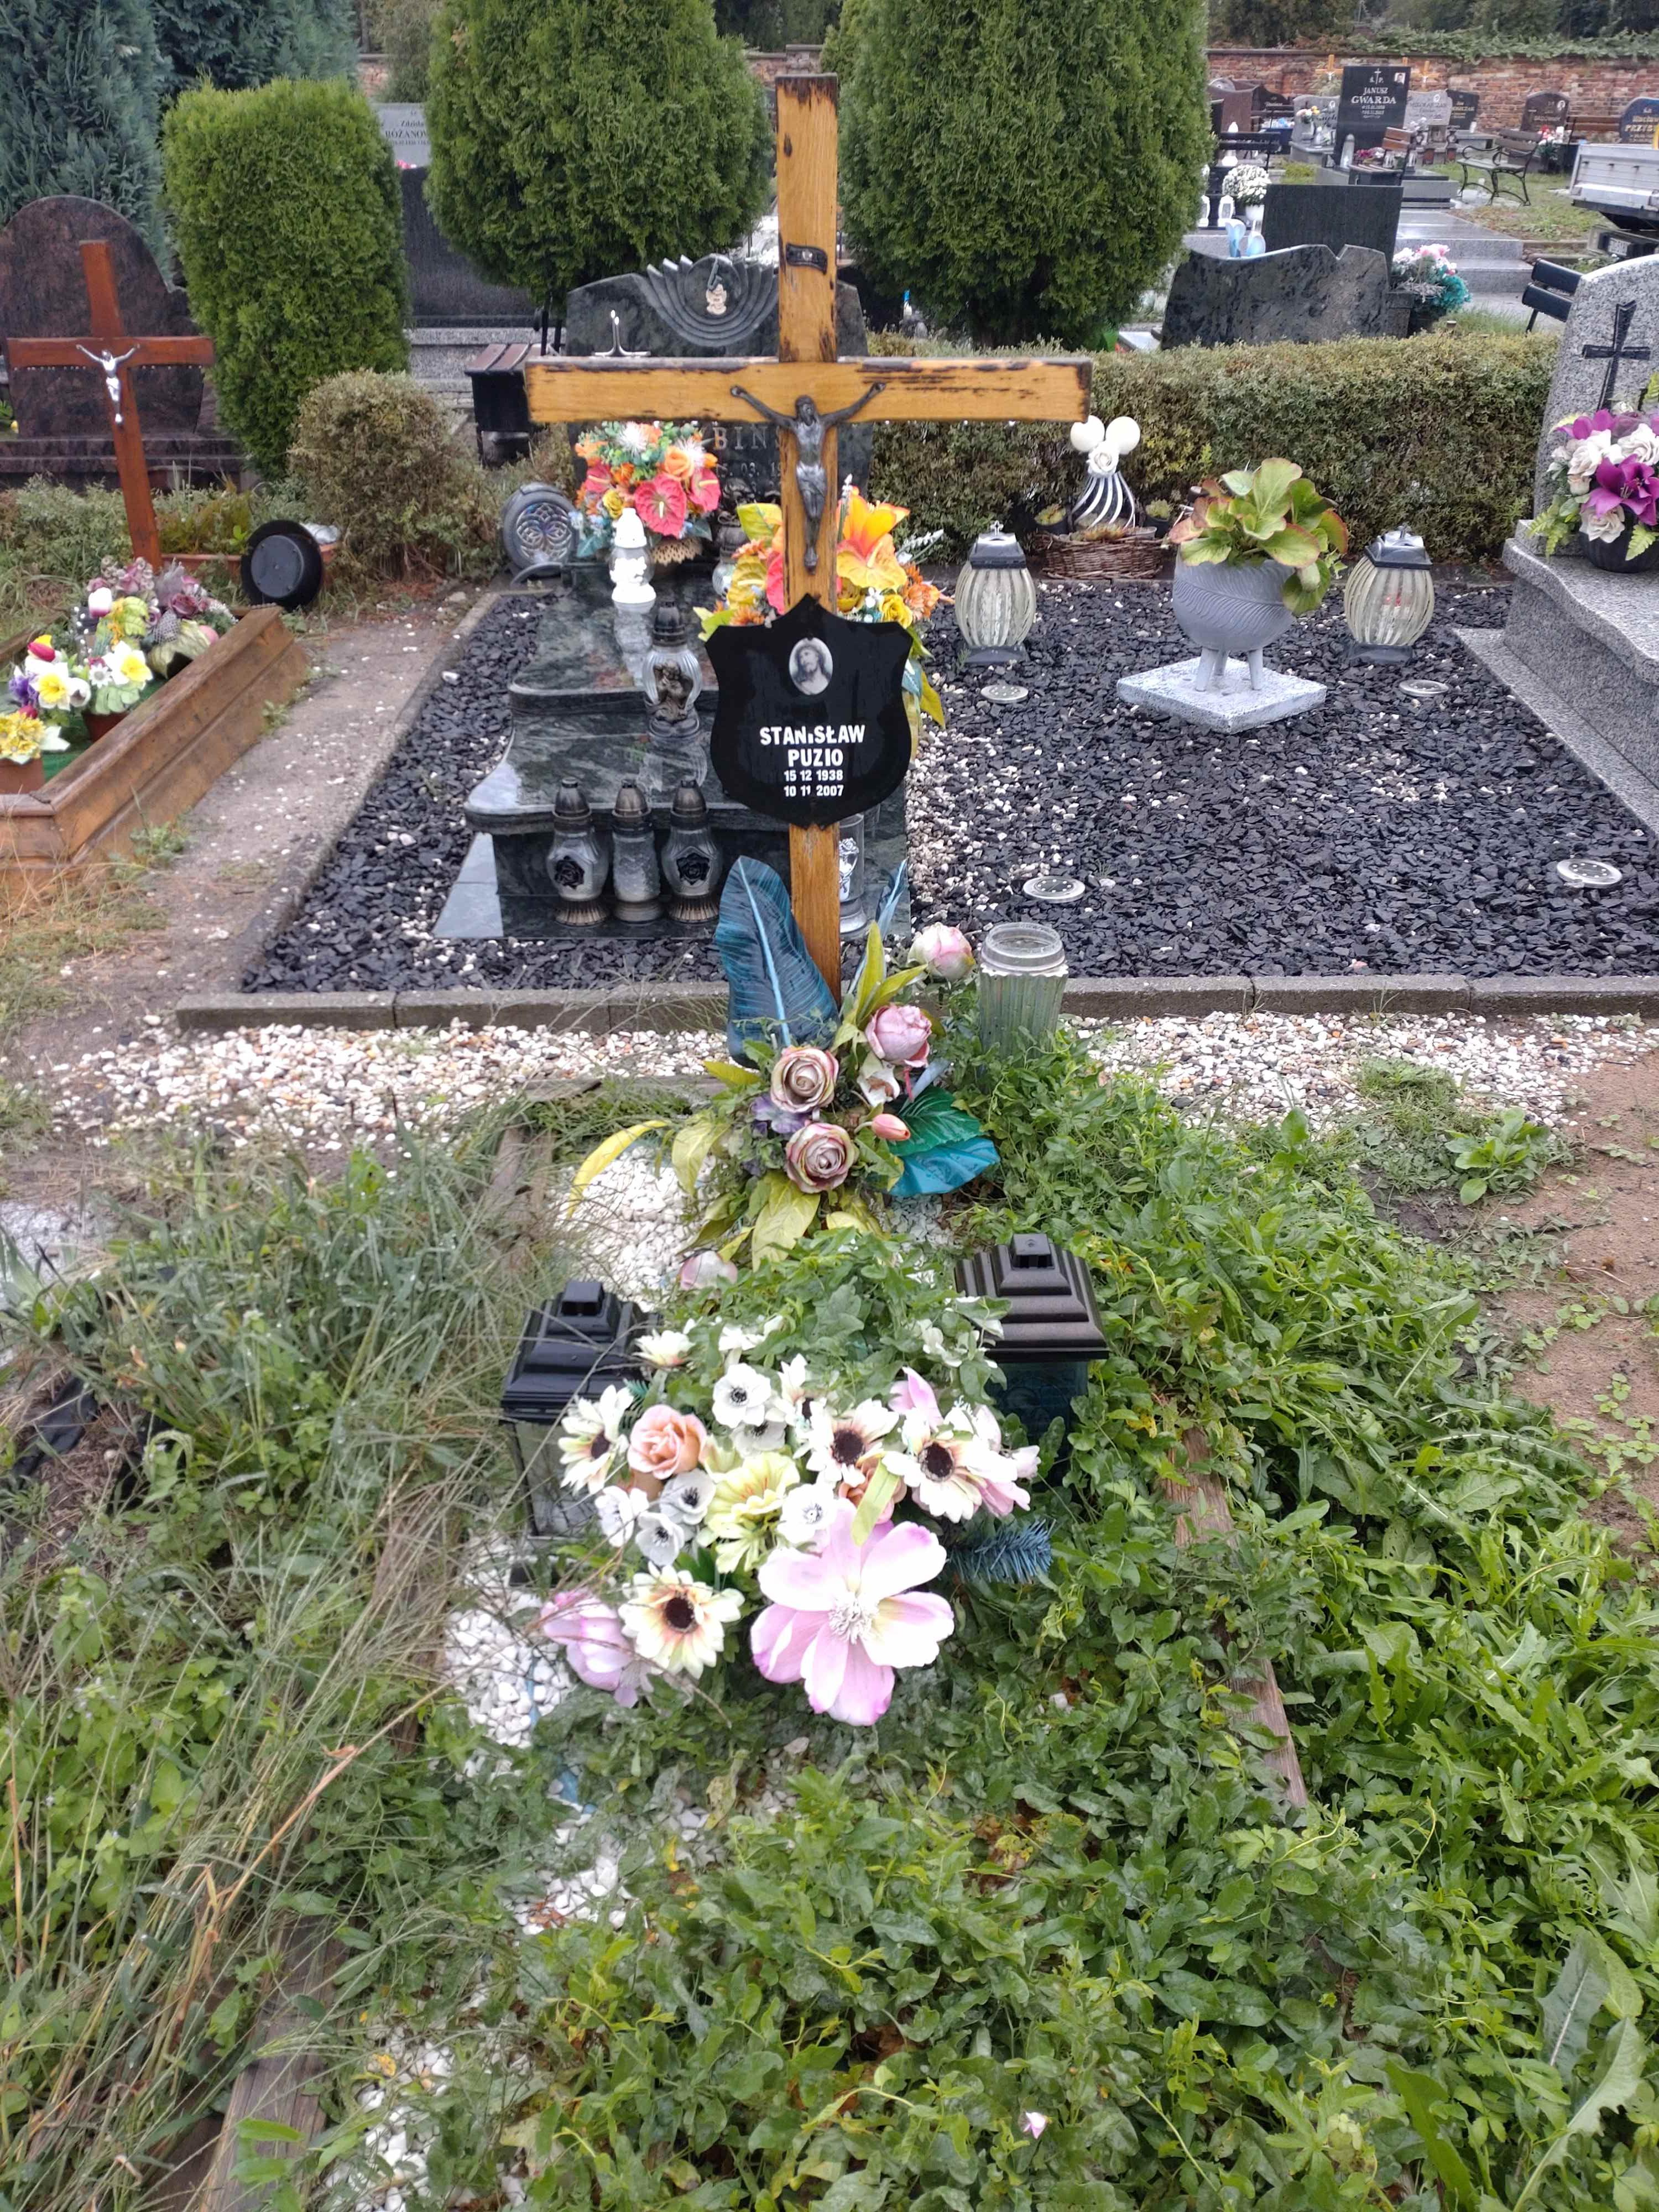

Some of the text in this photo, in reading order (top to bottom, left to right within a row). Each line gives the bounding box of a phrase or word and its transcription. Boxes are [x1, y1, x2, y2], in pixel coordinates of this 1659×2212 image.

[1363, 87, 1389, 96] JANUSZ
[1351, 95, 1397, 104] GWARDA
[712, 425, 780, 450] BIN
[760, 725, 865, 745] STANISŁAW
[788, 748, 843, 767] PUZIO
[784, 770, 843, 781] 15 12 1938
[784, 785, 843, 796] 10 11 2007
